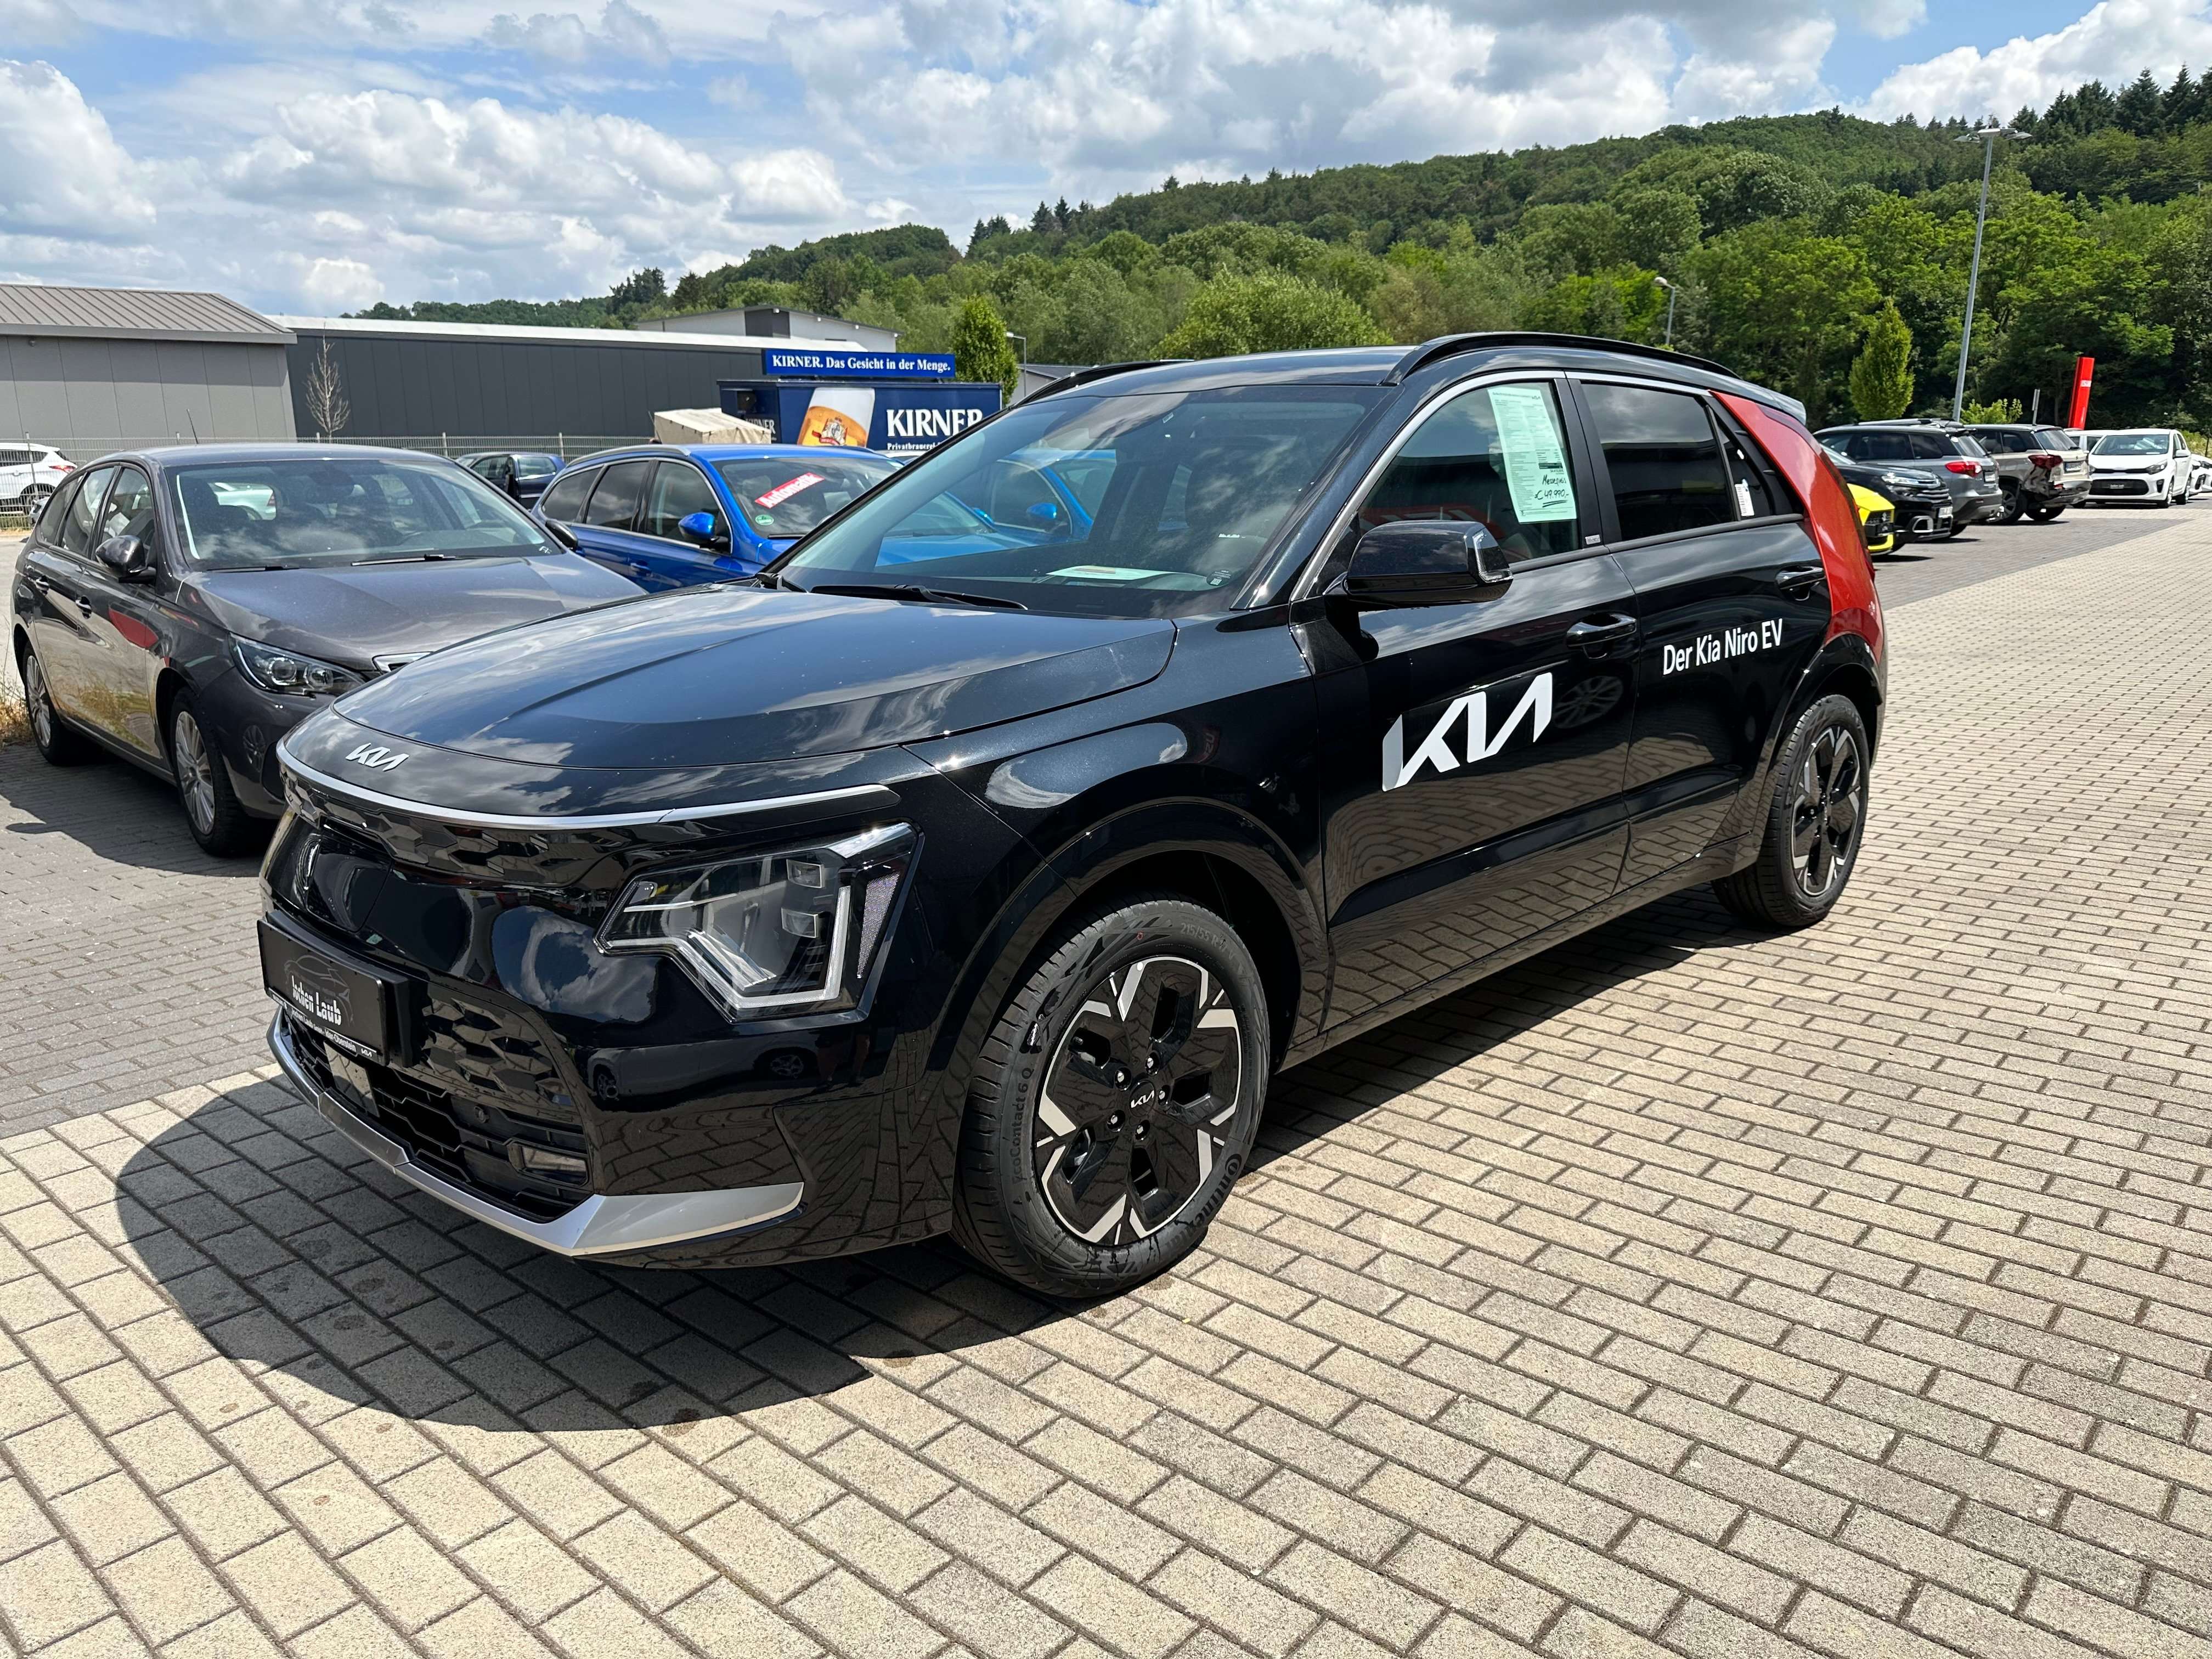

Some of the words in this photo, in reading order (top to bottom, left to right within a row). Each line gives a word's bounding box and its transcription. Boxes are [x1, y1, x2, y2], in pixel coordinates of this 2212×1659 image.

[772, 355, 823, 368] KIRNER.
[826, 357, 845, 368] Das
[848, 357, 884, 369] Gesicht
[887, 358, 896, 369] in
[899, 359, 915, 370] der
[917, 359, 951, 373] Menge.
[758, 472, 824, 508] Automatik
[1663, 644, 1693, 675] Der
[1696, 634, 1720, 666] Kia
[1725, 627, 1758, 658] Niro
[1762, 618, 1782, 649] EV
[1382, 672, 1553, 792] KIA
[345, 742, 409, 772] KIA
[315, 991, 341, 1025] Laub
[361, 1048, 373, 1058] KIA
[1021, 1068, 1035, 1080] Q
[1018, 1082, 1029, 1093] 6
[1131, 1090, 1155, 1108] KIA
